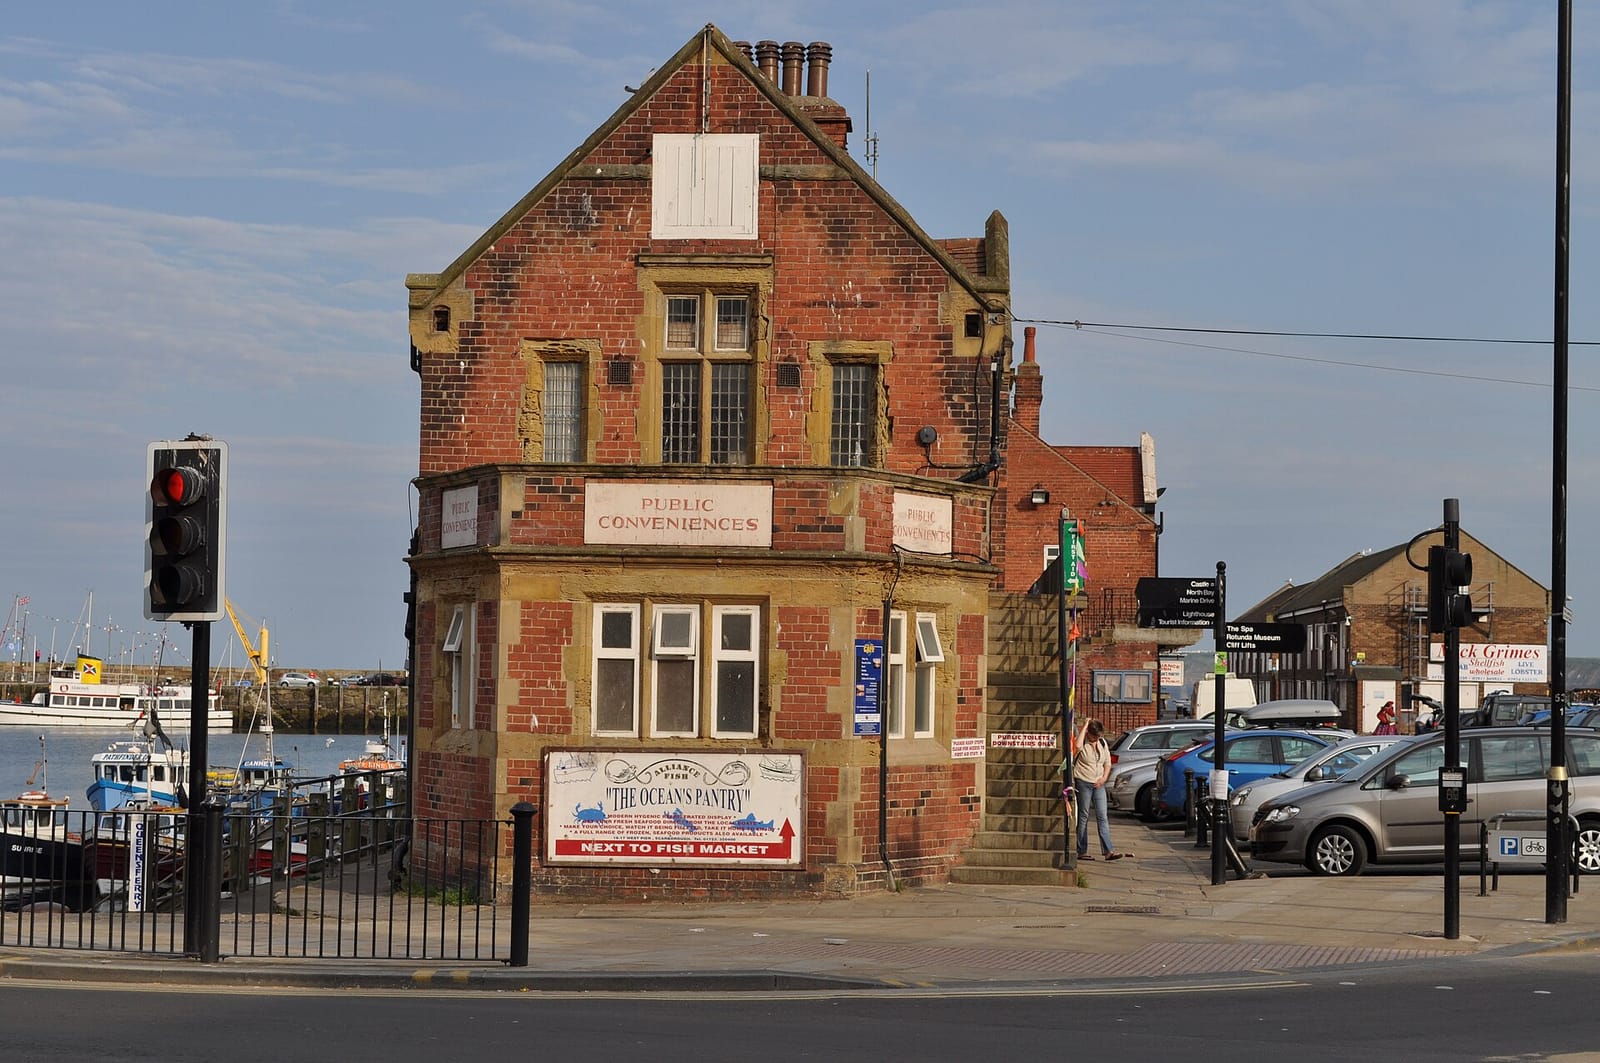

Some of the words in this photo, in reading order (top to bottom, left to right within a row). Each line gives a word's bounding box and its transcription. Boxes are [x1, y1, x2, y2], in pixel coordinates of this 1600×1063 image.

[642, 498, 714, 512] PUBLIC
[907, 508, 936, 523] PUBLIC
[599, 515, 759, 531] CONVENIENCES
[1190, 580, 1210, 588] Castle
[1203, 589, 1215, 597] Bay
[1182, 611, 1215, 619] Lighthouse
[1240, 625, 1254, 633] Spa
[1226, 633, 1253, 641] Rotunda
[1226, 641, 1240, 649] Cliff
[1240, 641, 1256, 649] Lifts
[1483, 644, 1540, 659] Grimes
[1469, 659, 1505, 668] Shellfish
[1469, 667, 1505, 676] wholesale
[654, 763, 701, 779] ALLIANCE
[606, 787, 637, 811] "THE
[640, 787, 692, 806] OCEAN'S
[695, 788, 751, 813] PANTRY"
[11, 844, 43, 854] SURIE
[580, 842, 625, 853] NEXT
[629, 843, 652, 853] TO
[656, 843, 695, 854] FISH
[699, 844, 769, 855] MARKET
[1504, 839, 1517, 854] P
[134, 823, 145, 909] QUEENSFERRY
